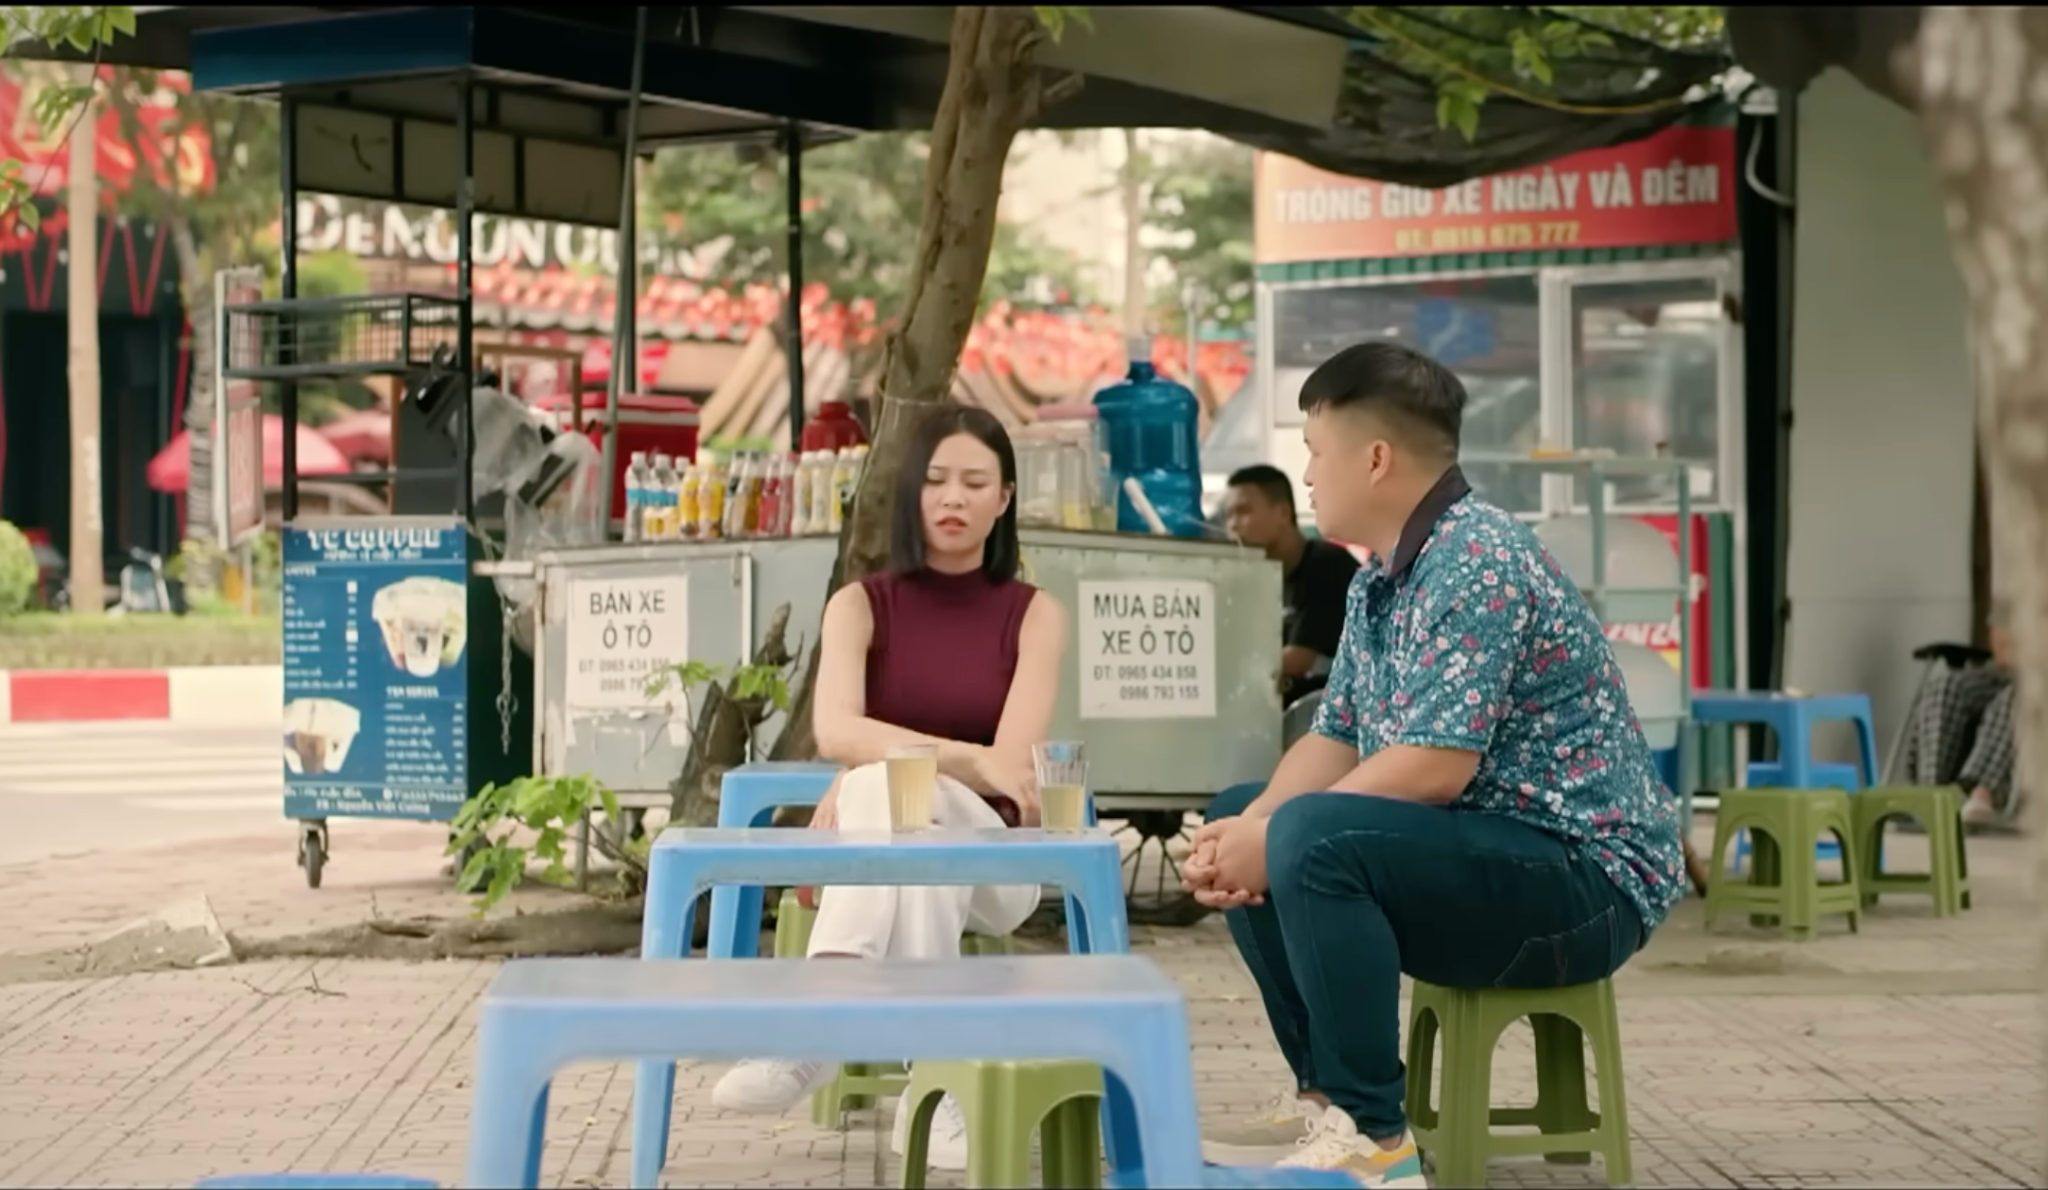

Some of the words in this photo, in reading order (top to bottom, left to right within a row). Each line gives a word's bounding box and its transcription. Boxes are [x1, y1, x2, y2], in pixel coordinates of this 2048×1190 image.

[1491, 165, 1580, 212] NGÀY
[1588, 160, 1633, 208] VÀ
[590, 585, 632, 615] BÁN
[639, 590, 665, 613] XE
[1094, 594, 1146, 618] MUA
[1153, 588, 1201, 618] BÁN
[603, 619, 618, 649] Ô
[624, 619, 652, 649] TÔ
[1102, 630, 1131, 655] XE
[1139, 624, 1157, 655] Ô
[1163, 624, 1195, 655] TÔ
[1118, 665, 1148, 680] 0965
[1151, 665, 1173, 680] 434
[1120, 685, 1149, 700] 0986
[1153, 685, 1174, 700] 793
[1179, 685, 1200, 700] 155
